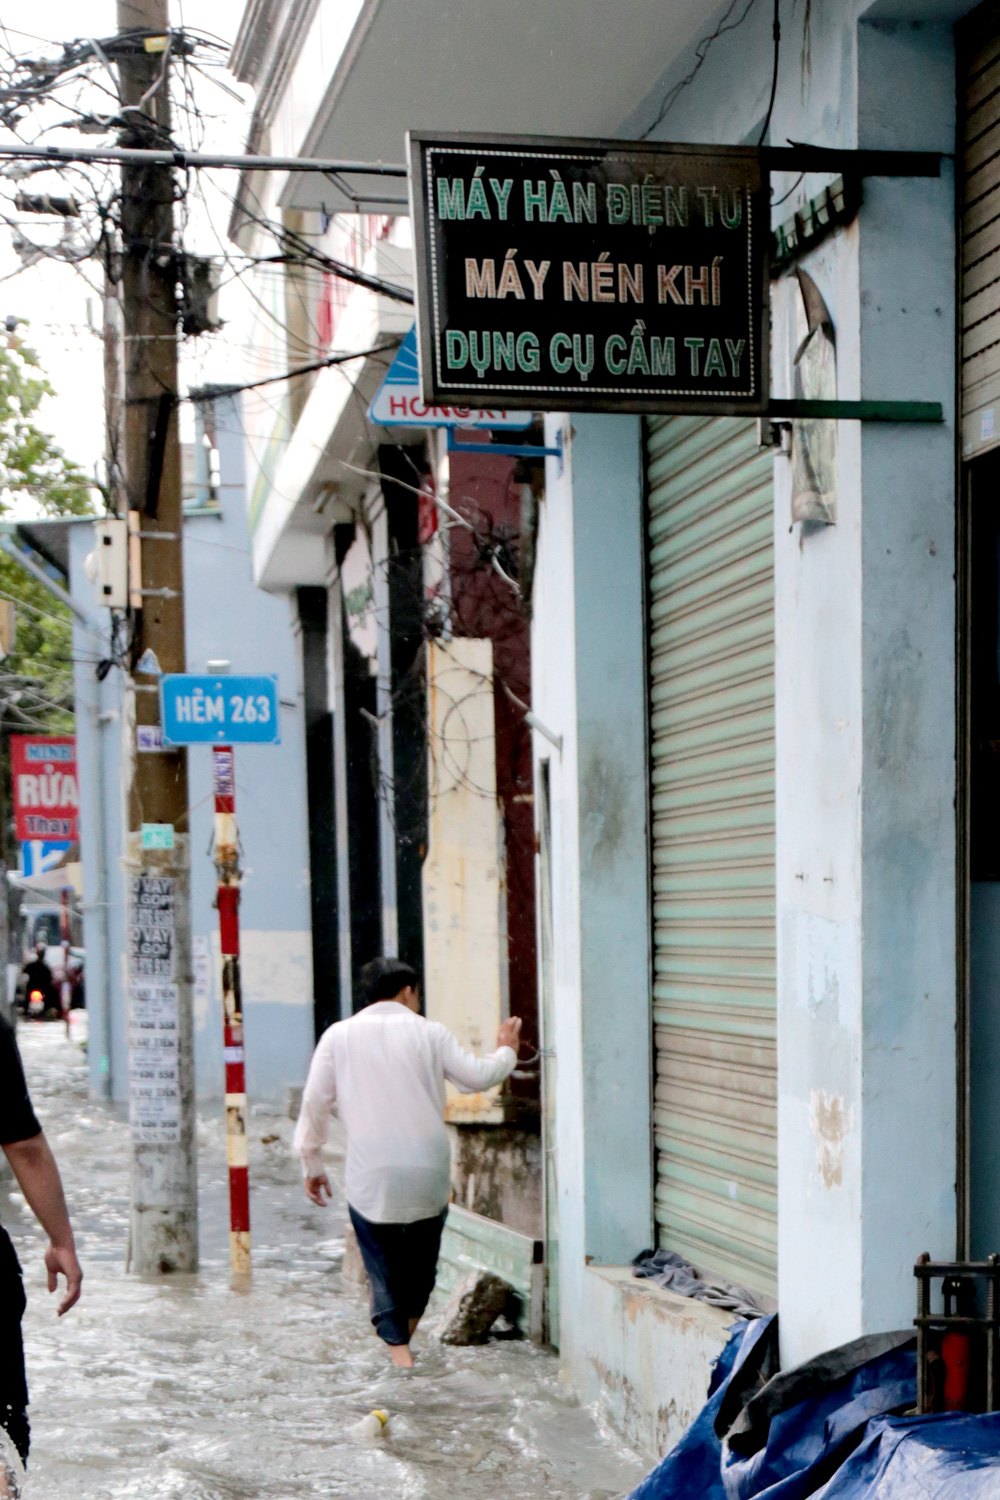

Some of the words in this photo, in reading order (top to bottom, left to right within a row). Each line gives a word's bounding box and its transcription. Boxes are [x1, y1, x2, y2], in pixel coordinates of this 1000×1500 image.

[436, 166, 513, 220] MÁY
[523, 169, 597, 224] HÀN
[606, 174, 688, 234] ĐIỆN
[464, 248, 551, 300] MÁY
[562, 252, 644, 304] NÉN
[657, 256, 723, 306] KHÍ
[445, 329, 541, 378] DỤNG
[549, 333, 595, 381] CỤ
[603, 318, 676, 376] CẦM
[683, 337, 746, 378] TAY
[229, 695, 272, 723] 263
[17, 763, 79, 807] RỬA
[26, 815, 71, 834] Thay
